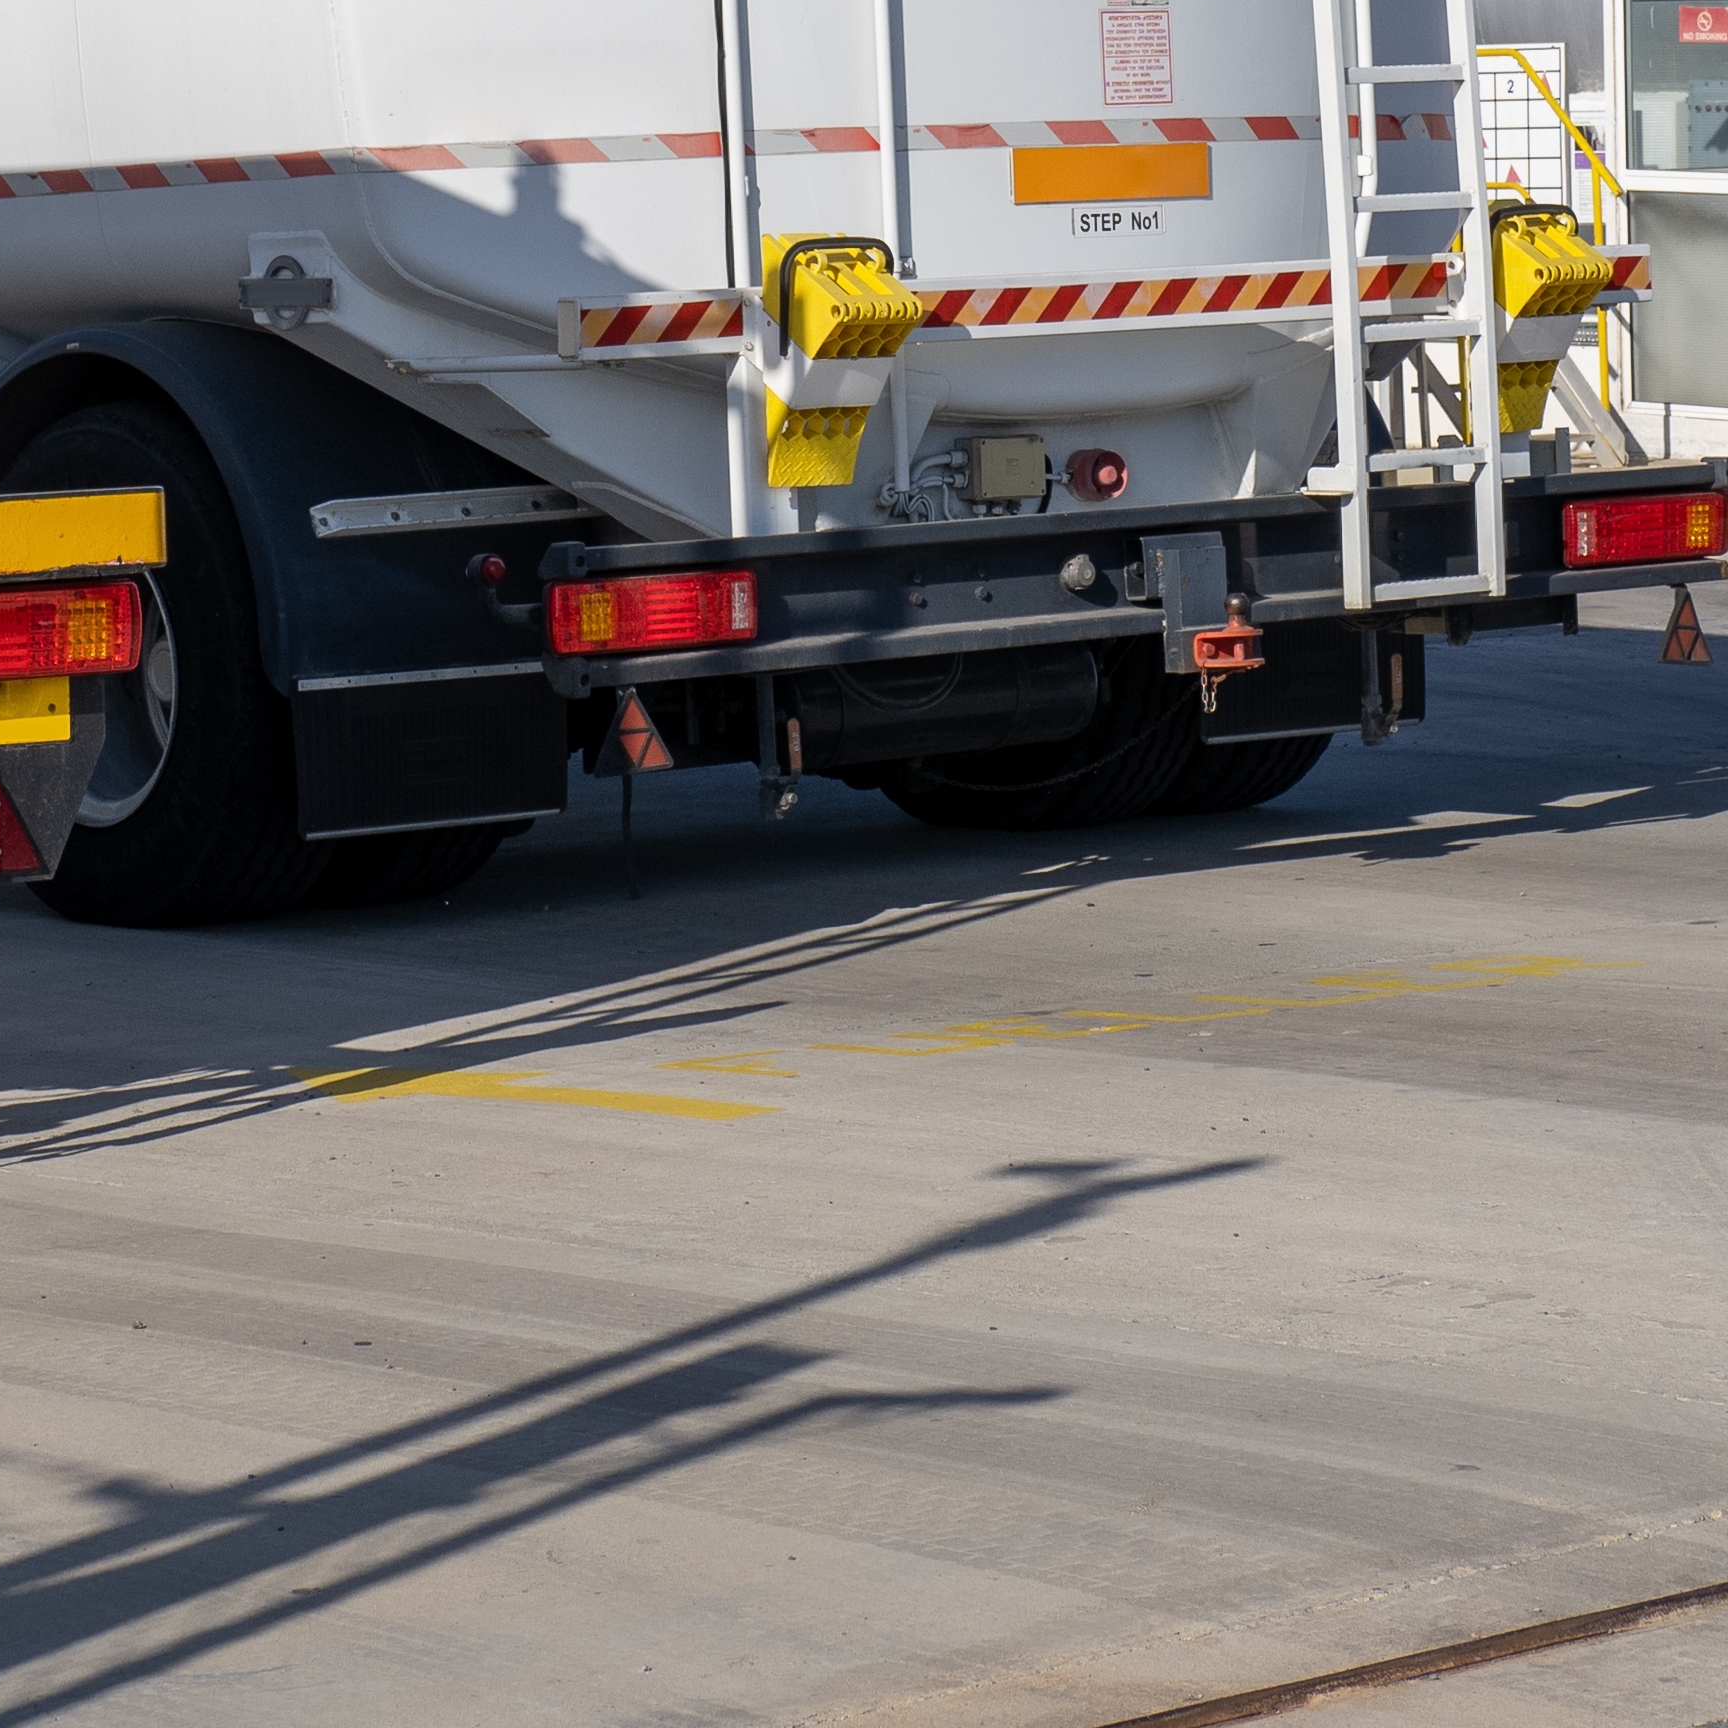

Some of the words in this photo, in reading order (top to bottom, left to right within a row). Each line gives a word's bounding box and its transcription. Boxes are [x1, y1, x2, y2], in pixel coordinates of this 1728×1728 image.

[1683, 32, 1694, 41] NO
[1695, 32, 1728, 41] SMOKING
[1507, 79, 1514, 94] 2
[1080, 212, 1122, 233] STEP
[1131, 211, 1159, 231] No1
